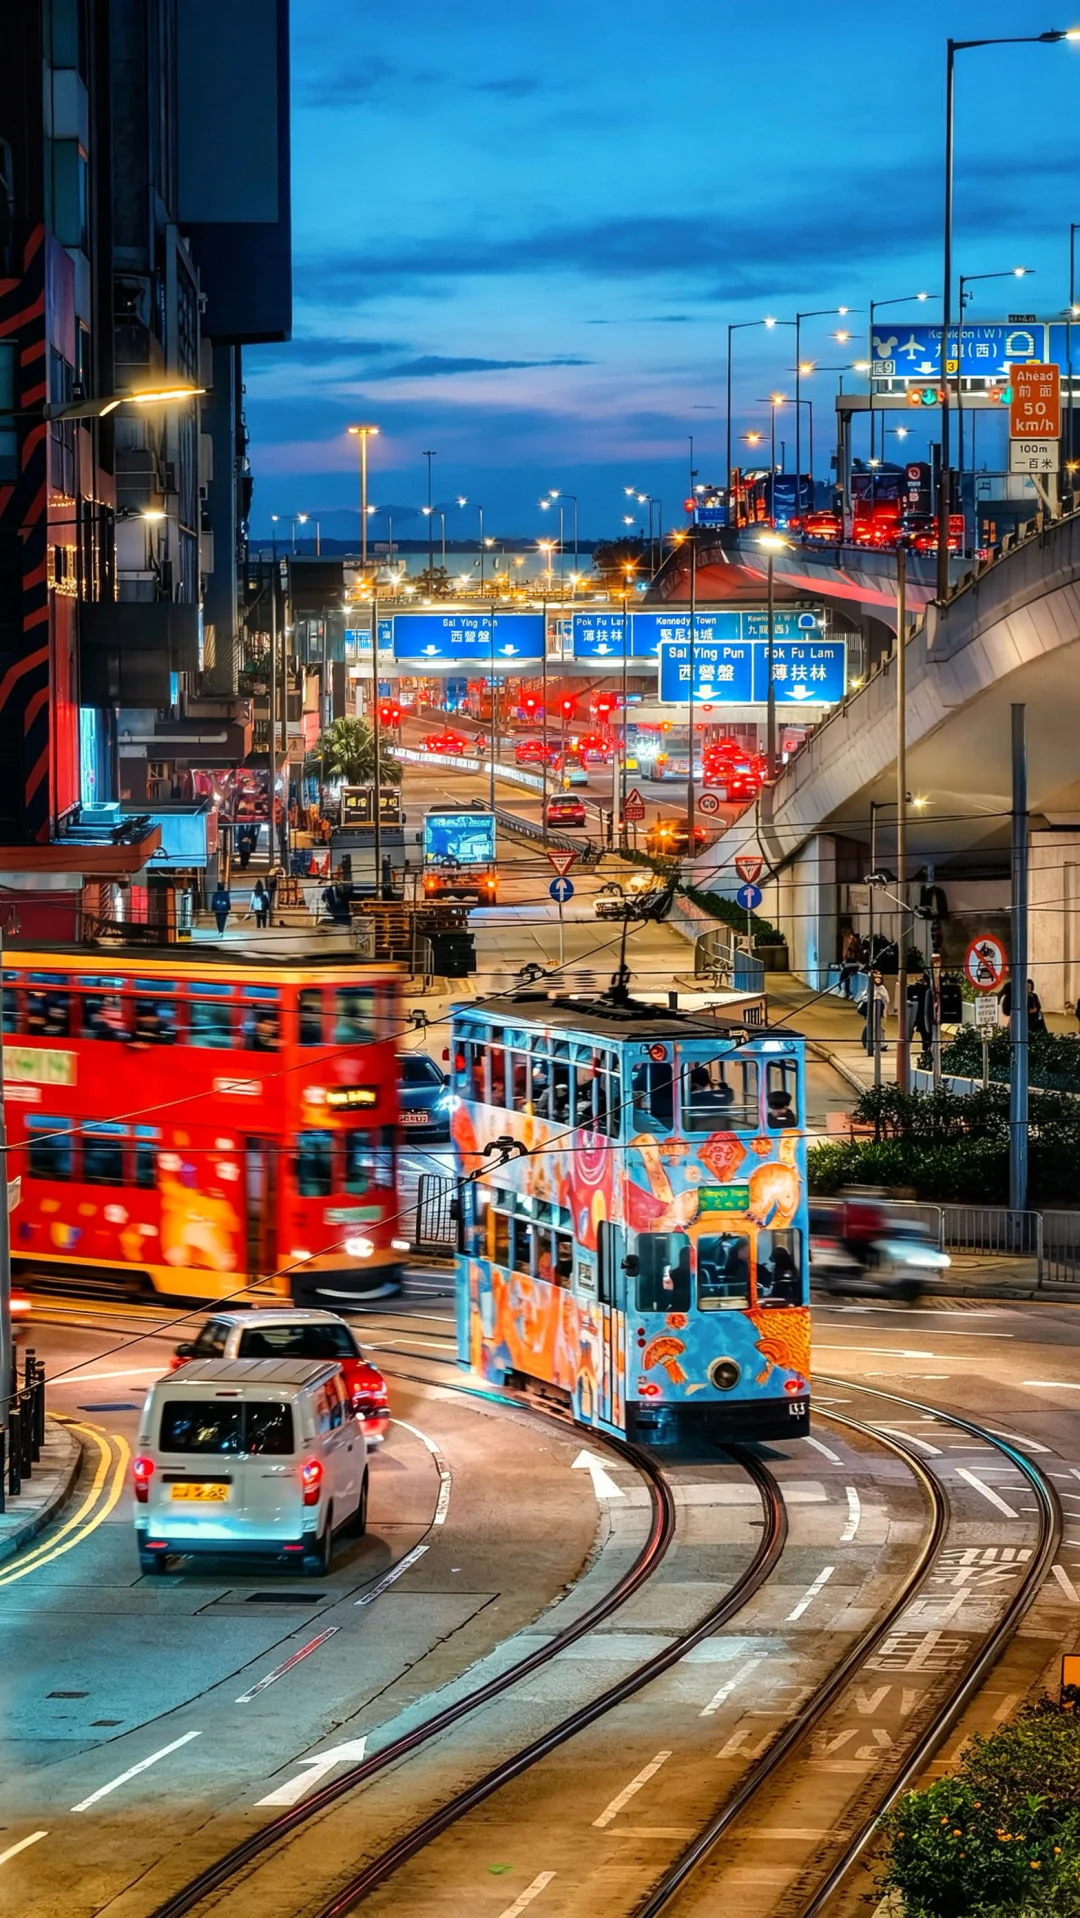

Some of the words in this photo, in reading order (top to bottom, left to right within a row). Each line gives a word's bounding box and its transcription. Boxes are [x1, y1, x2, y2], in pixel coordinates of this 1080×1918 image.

[948, 361, 954, 371] 3
[1017, 371, 1054, 381] Ahead
[1024, 402, 1047, 415] 50
[1015, 418, 1054, 431] km/h
[1020, 445, 1048, 453] 100m
[1014, 458, 1053, 469] 一百米
[460, 618, 478, 629] Ying
[576, 617, 593, 627] Pok
[596, 616, 608, 626] Fu
[656, 616, 692, 627] Kennedy
[695, 615, 717, 625] Town
[669, 646, 687, 659] Sai
[692, 646, 718, 662] Ying
[723, 646, 744, 659] Pun
[763, 647, 786, 659] Pok
[791, 647, 805, 659] Fu
[810, 647, 834, 659] Lam
[678, 664, 735, 681] 西營盤
[772, 663, 828, 681] 薄扶林
